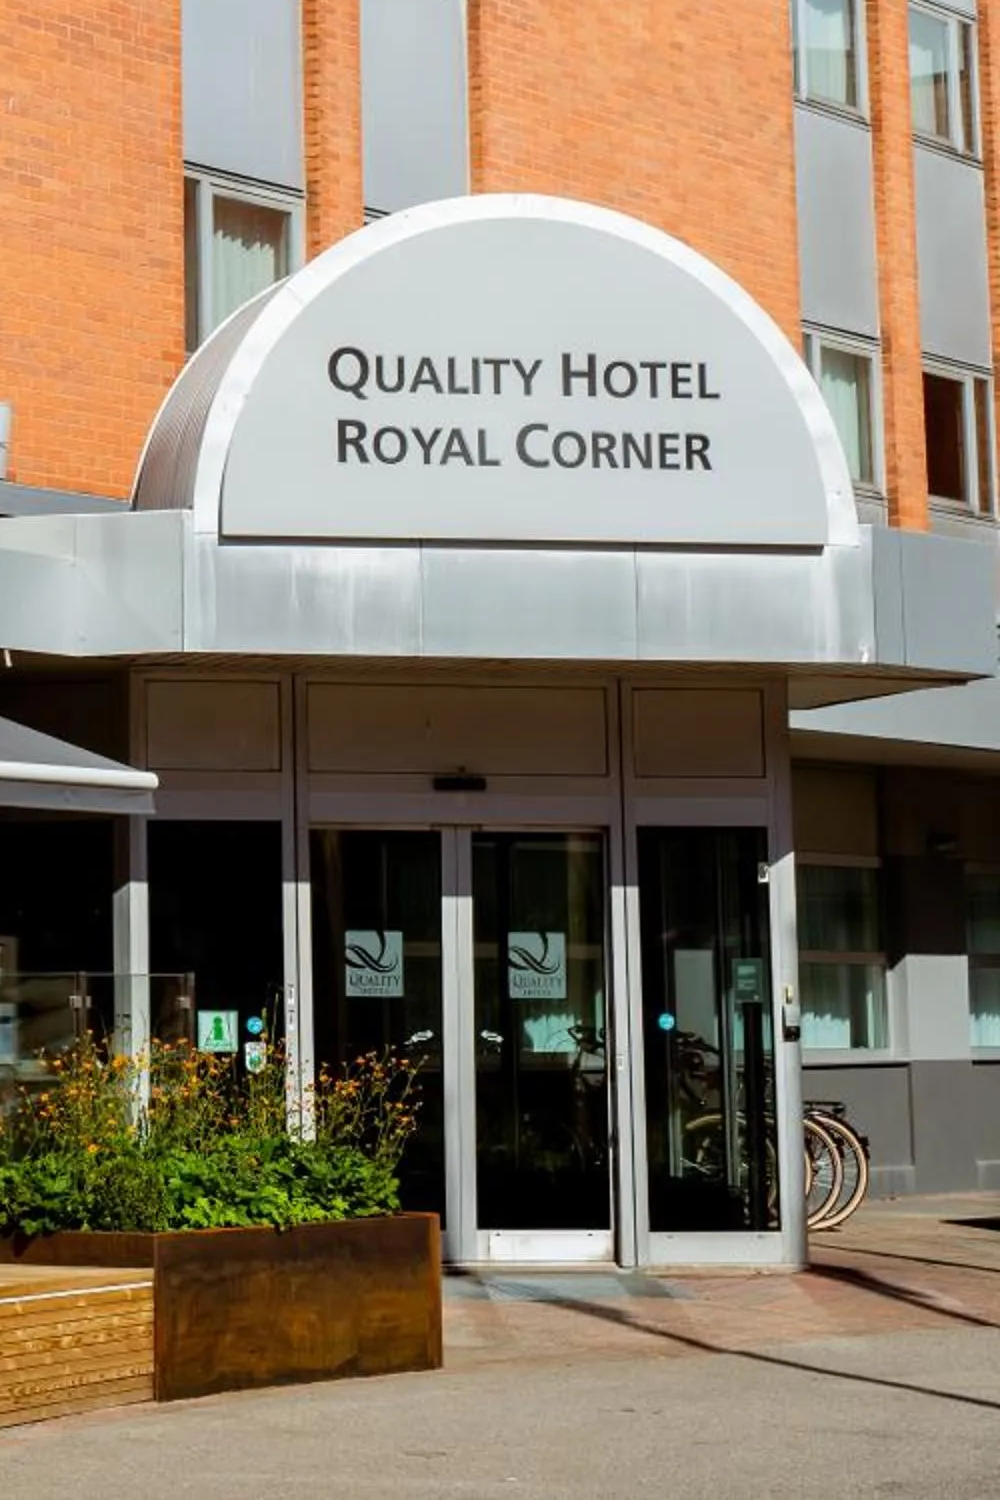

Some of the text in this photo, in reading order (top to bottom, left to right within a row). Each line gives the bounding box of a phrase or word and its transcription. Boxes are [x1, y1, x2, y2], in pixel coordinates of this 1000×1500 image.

[327, 346, 721, 400] QUALITY HOTEL
[336, 418, 713, 471] ROYAL CORNER
